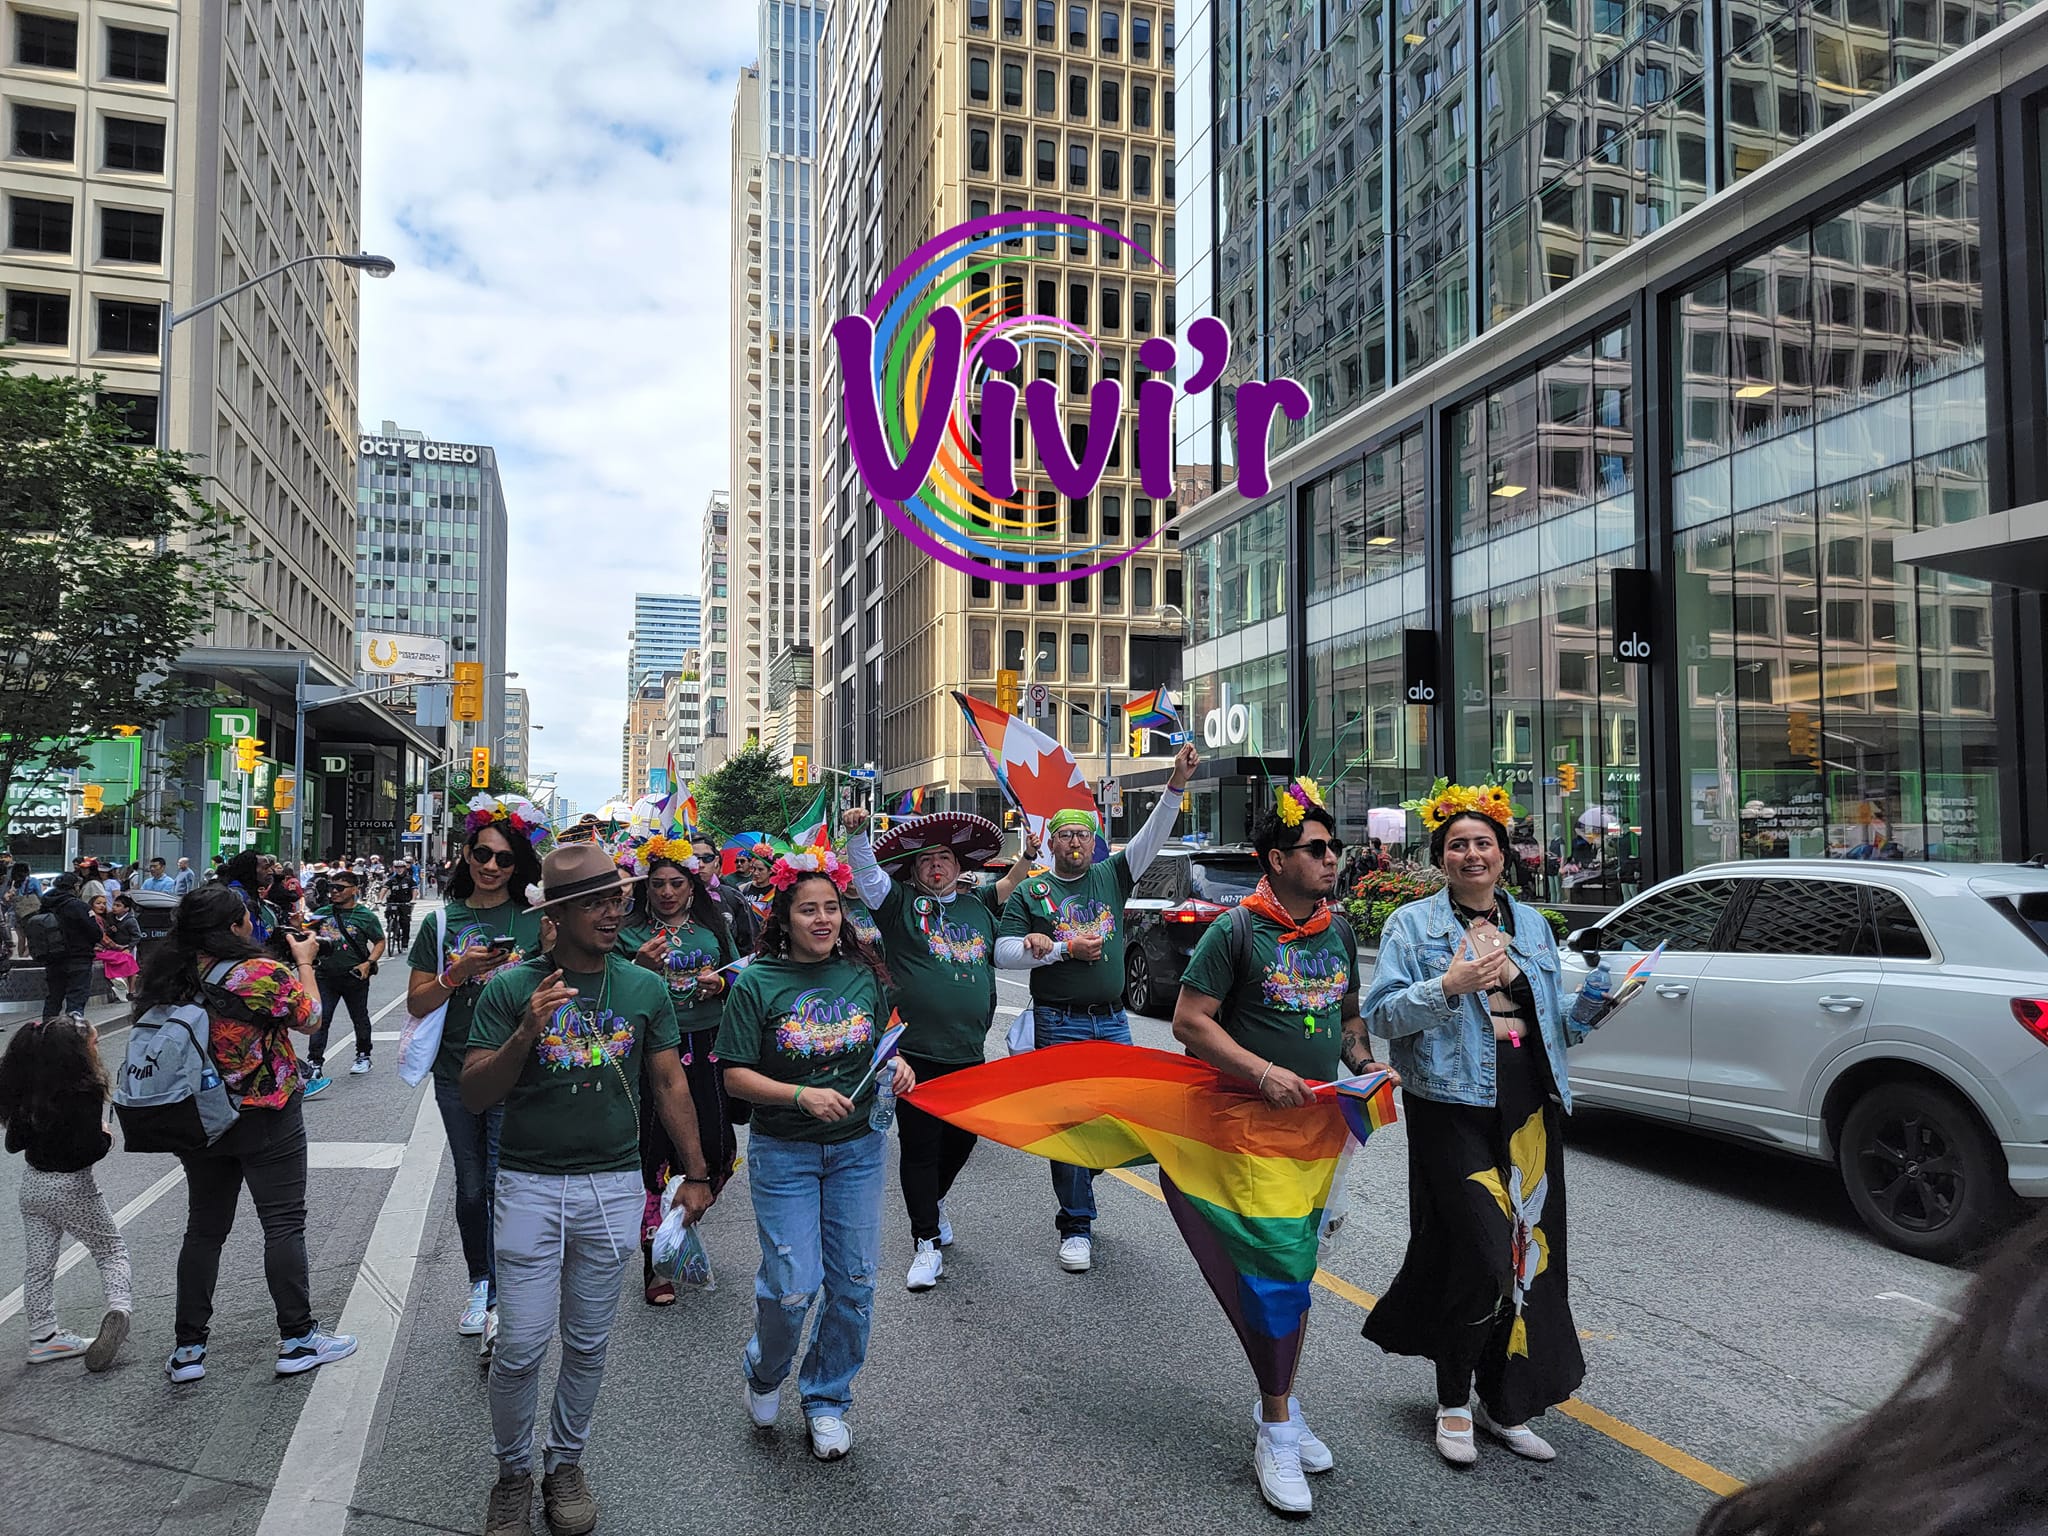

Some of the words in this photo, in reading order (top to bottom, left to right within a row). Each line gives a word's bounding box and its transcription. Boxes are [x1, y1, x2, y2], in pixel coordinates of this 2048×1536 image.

[359, 440, 400, 457] OCT
[423, 446, 477, 463] OEEO
[1619, 631, 1650, 657] alo
[1408, 680, 1434, 700] alo
[214, 714, 250, 736] TD
[1204, 683, 1248, 748] alo
[321, 757, 346, 772] TD
